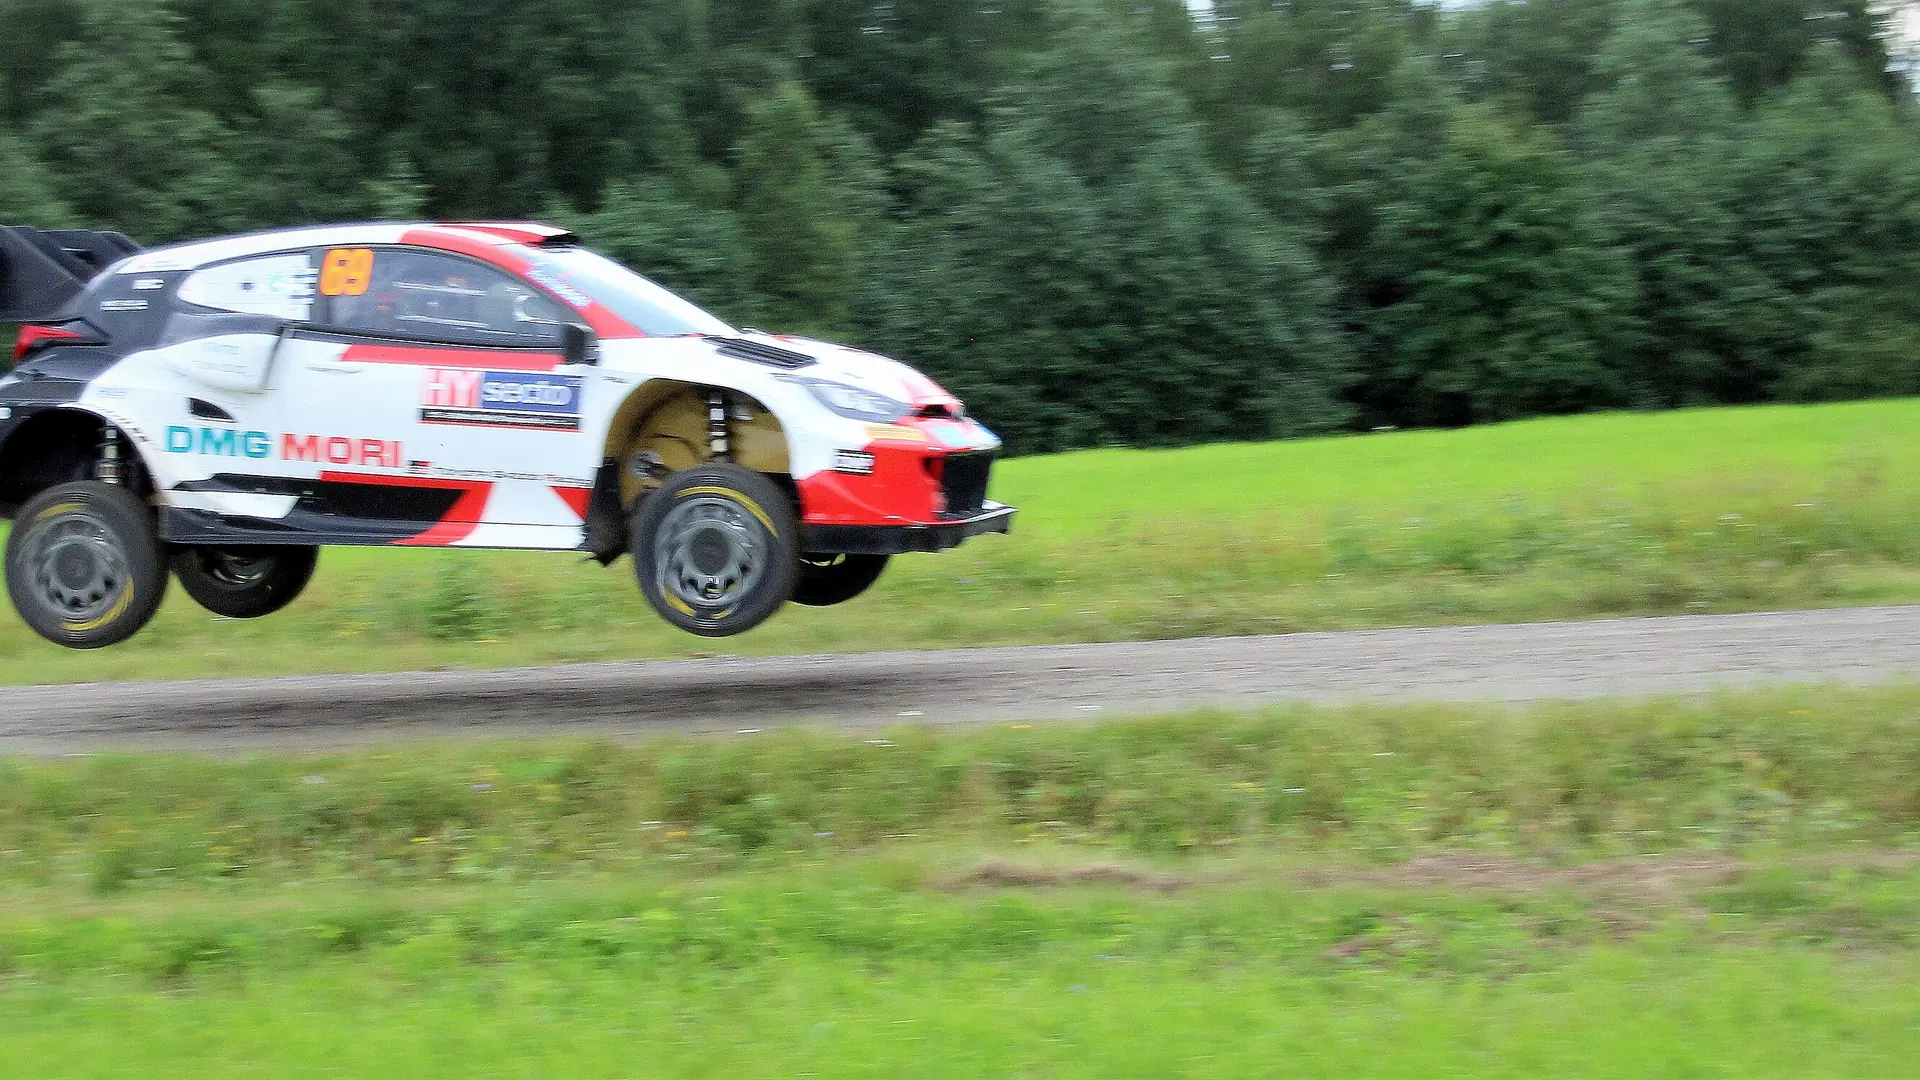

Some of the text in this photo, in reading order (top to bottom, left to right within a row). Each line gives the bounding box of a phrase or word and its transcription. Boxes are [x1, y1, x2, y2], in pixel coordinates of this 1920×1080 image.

[320, 248, 373, 296] 69
[422, 369, 480, 407] HY
[166, 425, 405, 468] DMG MORI
